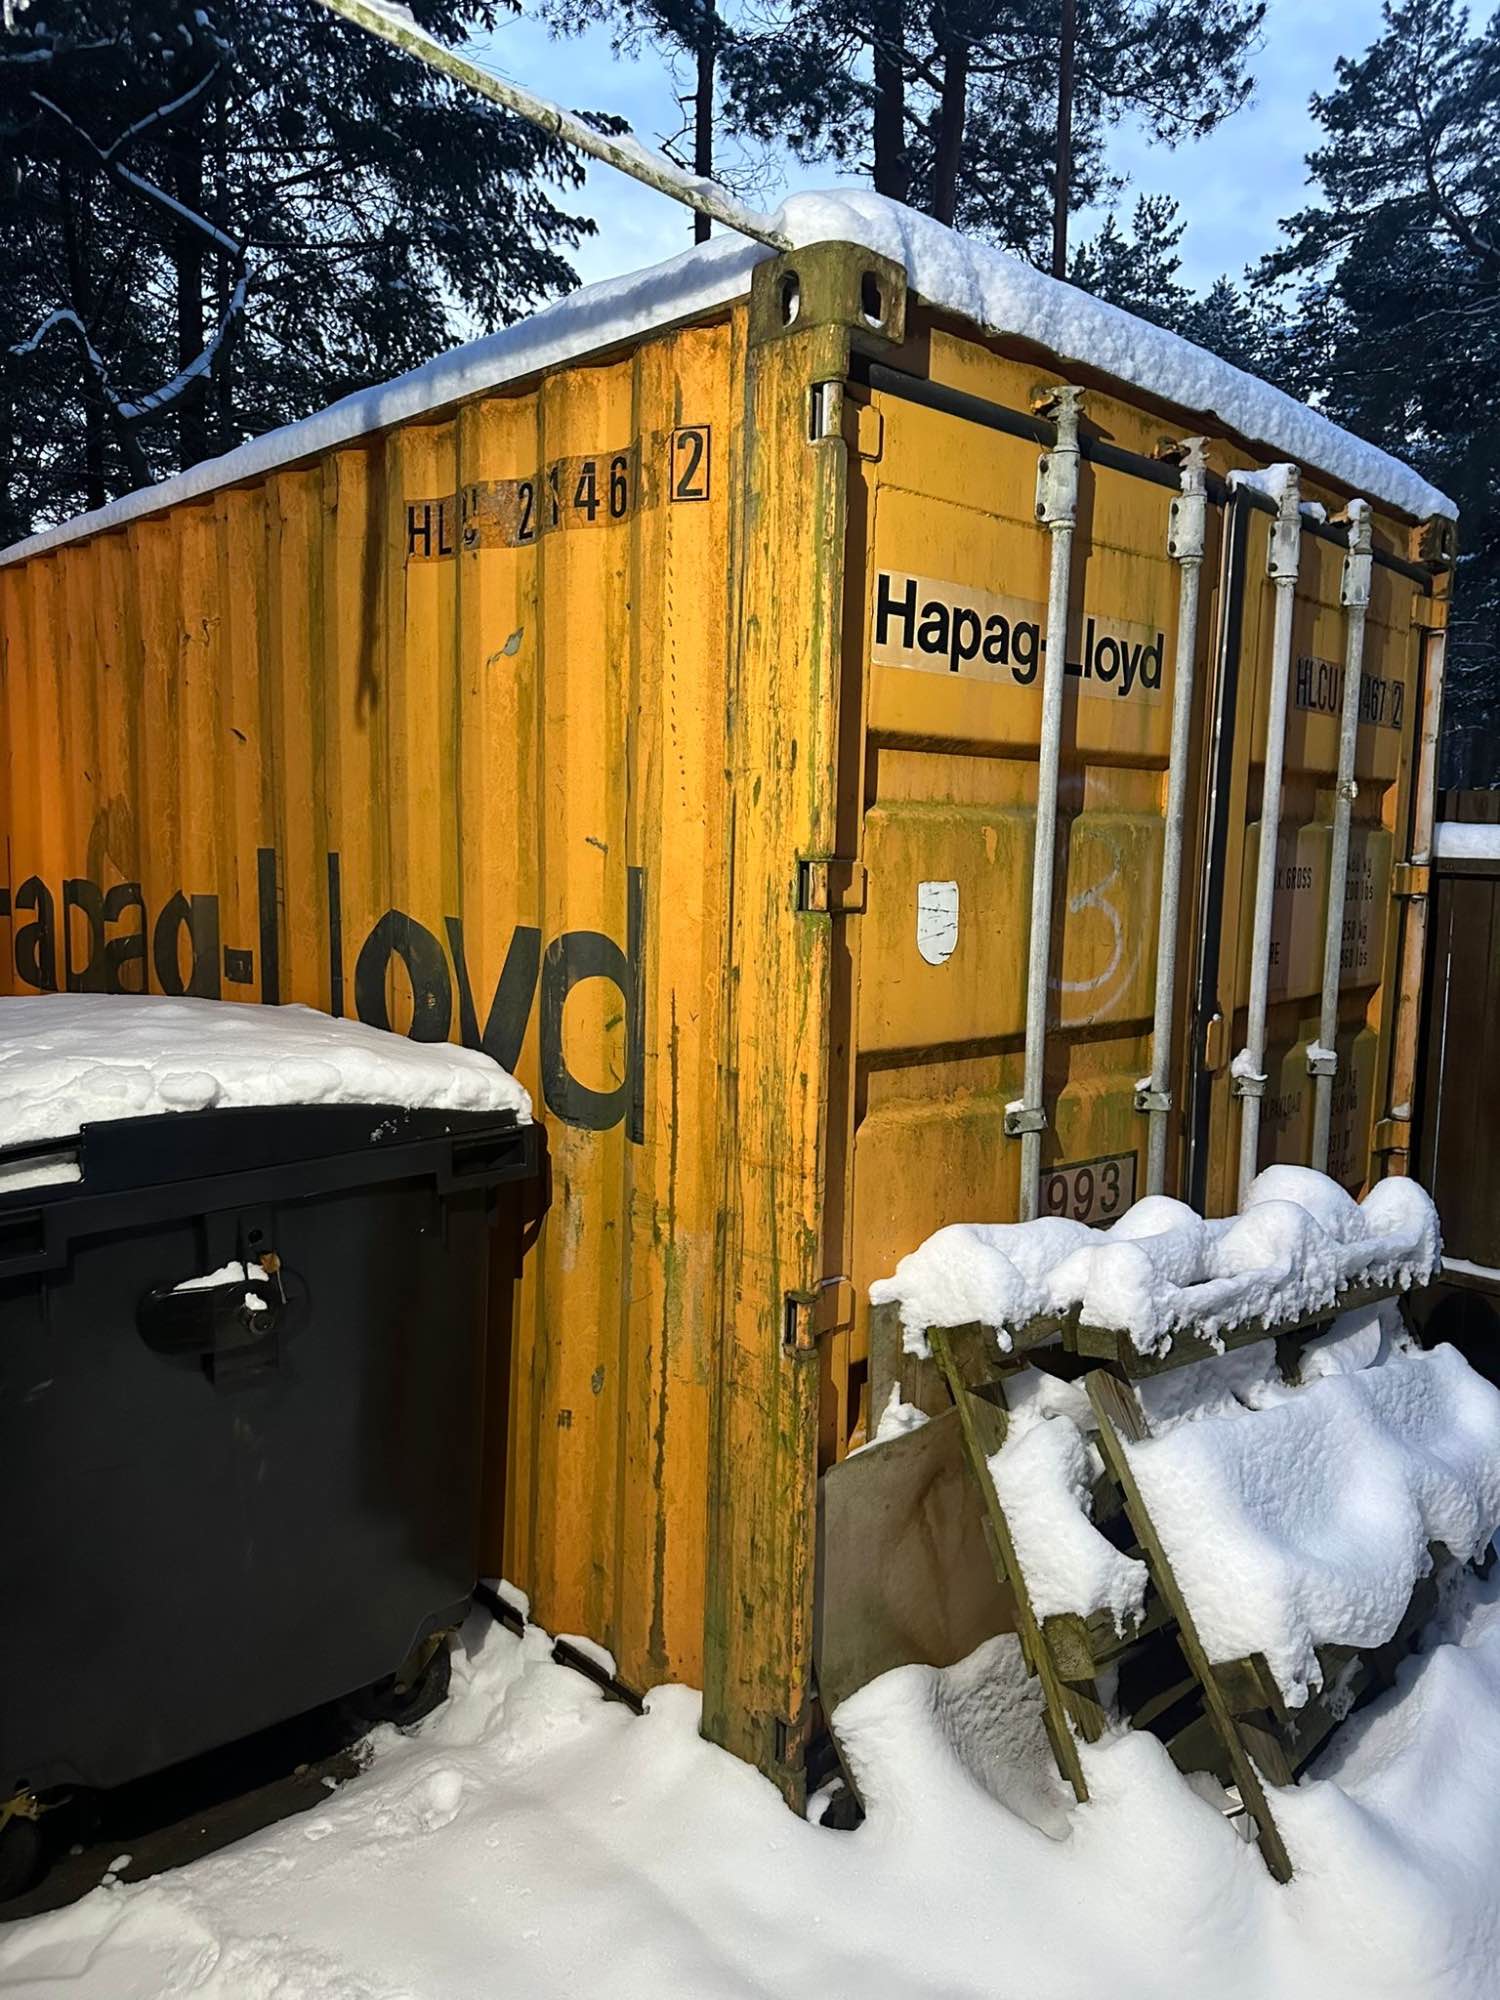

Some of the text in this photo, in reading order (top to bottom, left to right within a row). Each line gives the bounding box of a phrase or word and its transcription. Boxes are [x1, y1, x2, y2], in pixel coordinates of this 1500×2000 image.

[677, 431, 703, 497] 2
[1296, 658, 1338, 712] HLCU
[1286, 866, 1312, 889] GROSS
[0, 848, 645, 1145] apag-Lloyd
[1048, 1162, 1120, 1221] 993
